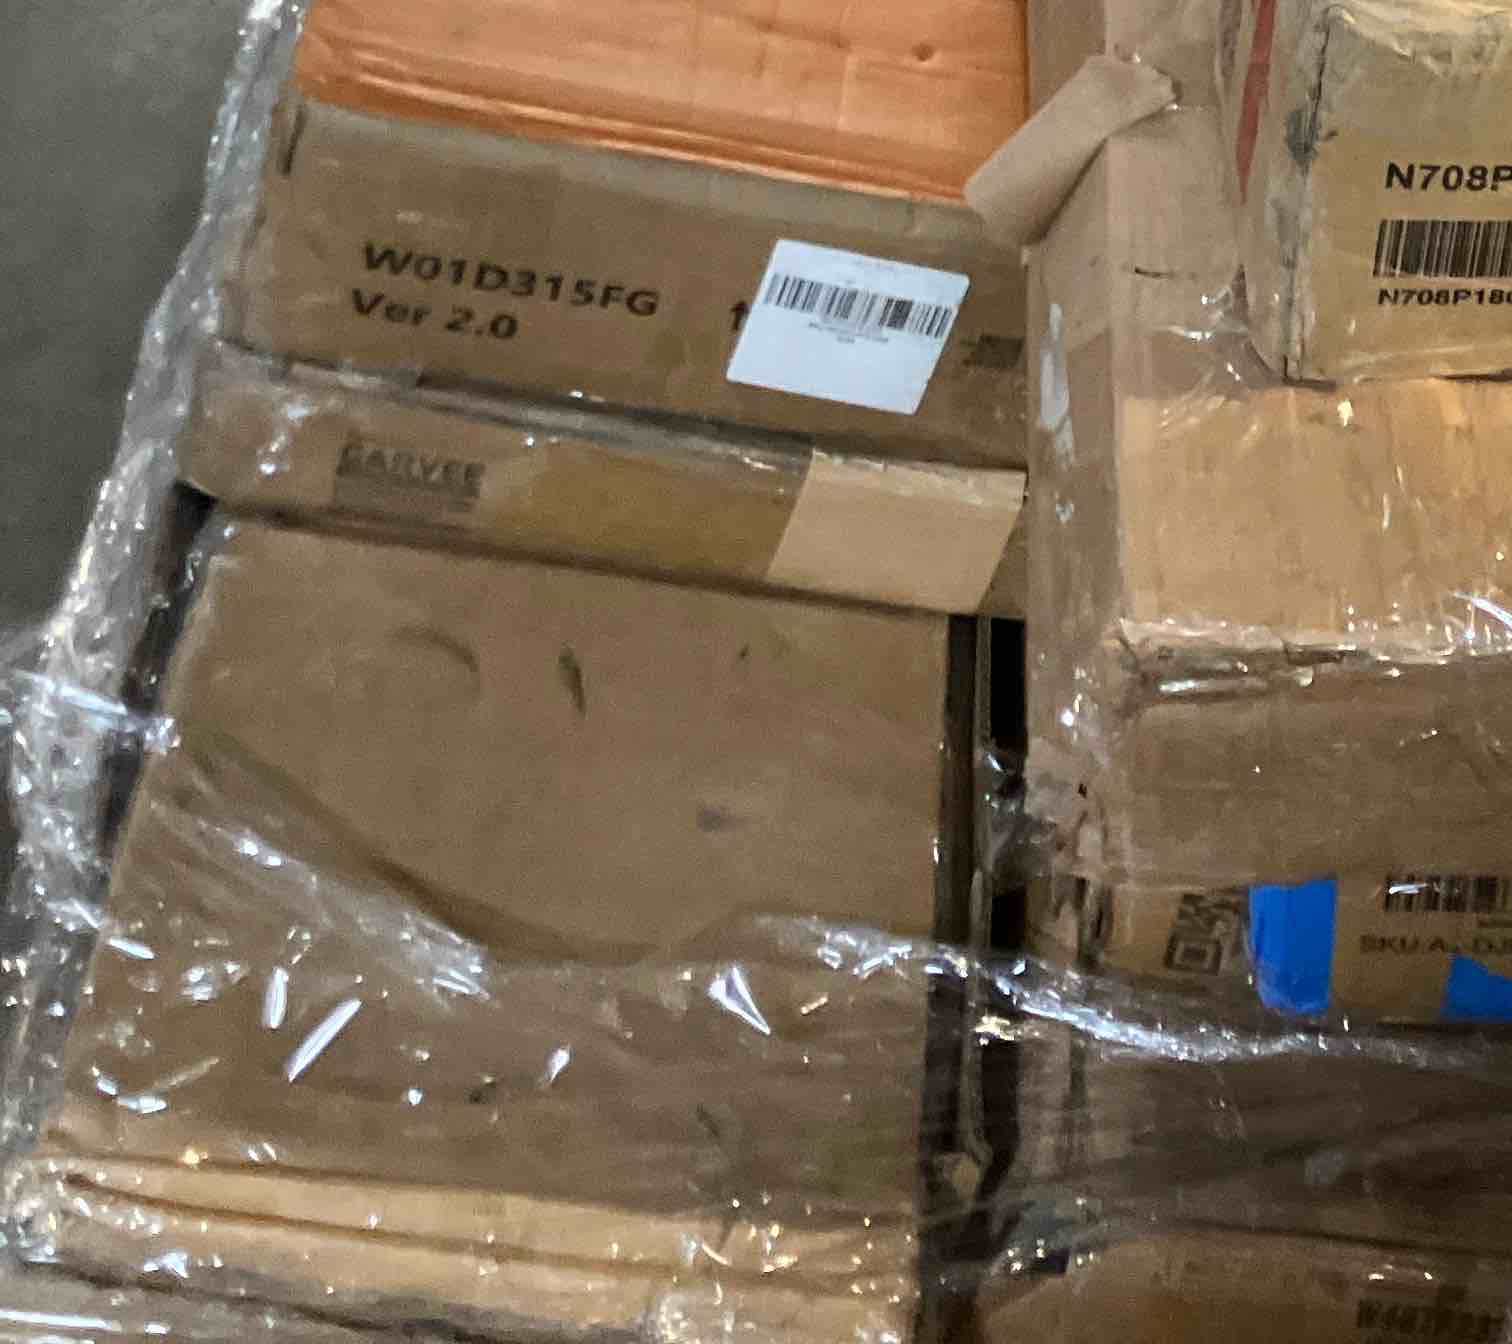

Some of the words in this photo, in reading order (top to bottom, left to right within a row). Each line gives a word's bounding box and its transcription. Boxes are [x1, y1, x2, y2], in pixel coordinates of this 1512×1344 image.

[363, 242, 659, 317] W01D315FG
[351, 288, 433, 327] Ver
[443, 305, 518, 341] 2.0
